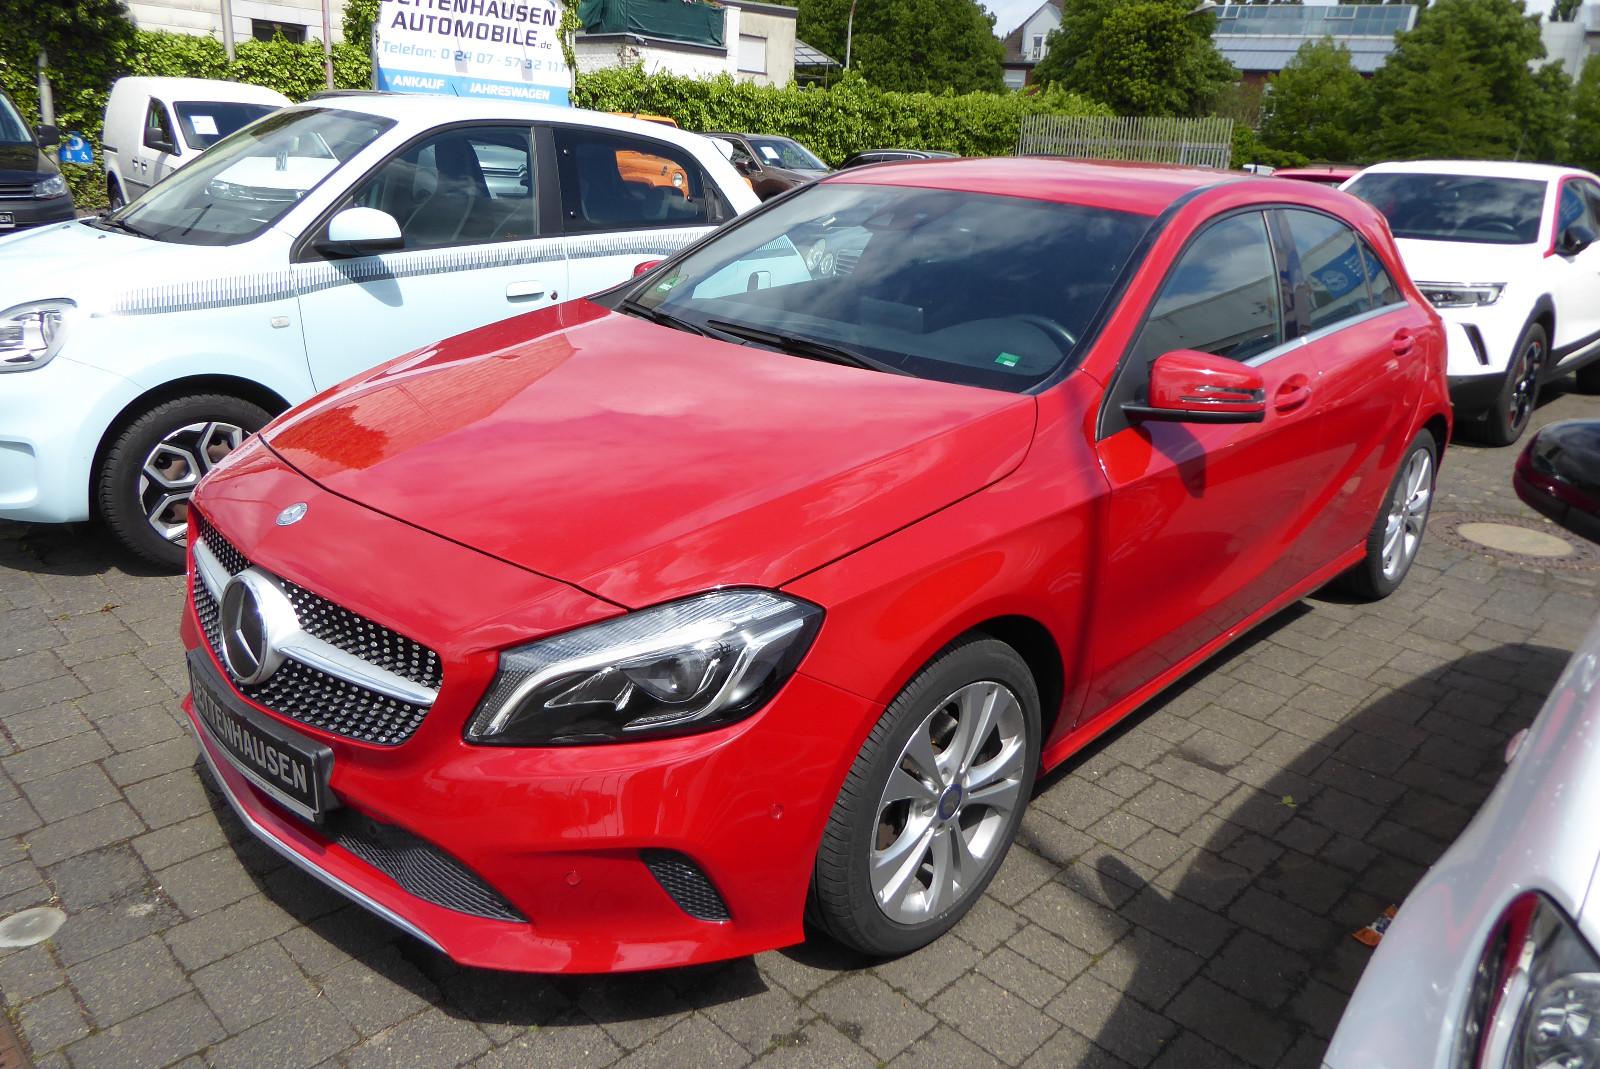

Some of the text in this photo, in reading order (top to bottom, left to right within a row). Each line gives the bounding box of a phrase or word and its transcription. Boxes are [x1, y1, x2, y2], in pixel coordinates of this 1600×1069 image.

[382, 0, 556, 26] ENHAUSEN
[382, 41, 436, 58] Telefon:
[392, 75, 551, 100] ANKAUF JAHRESWAGEN
